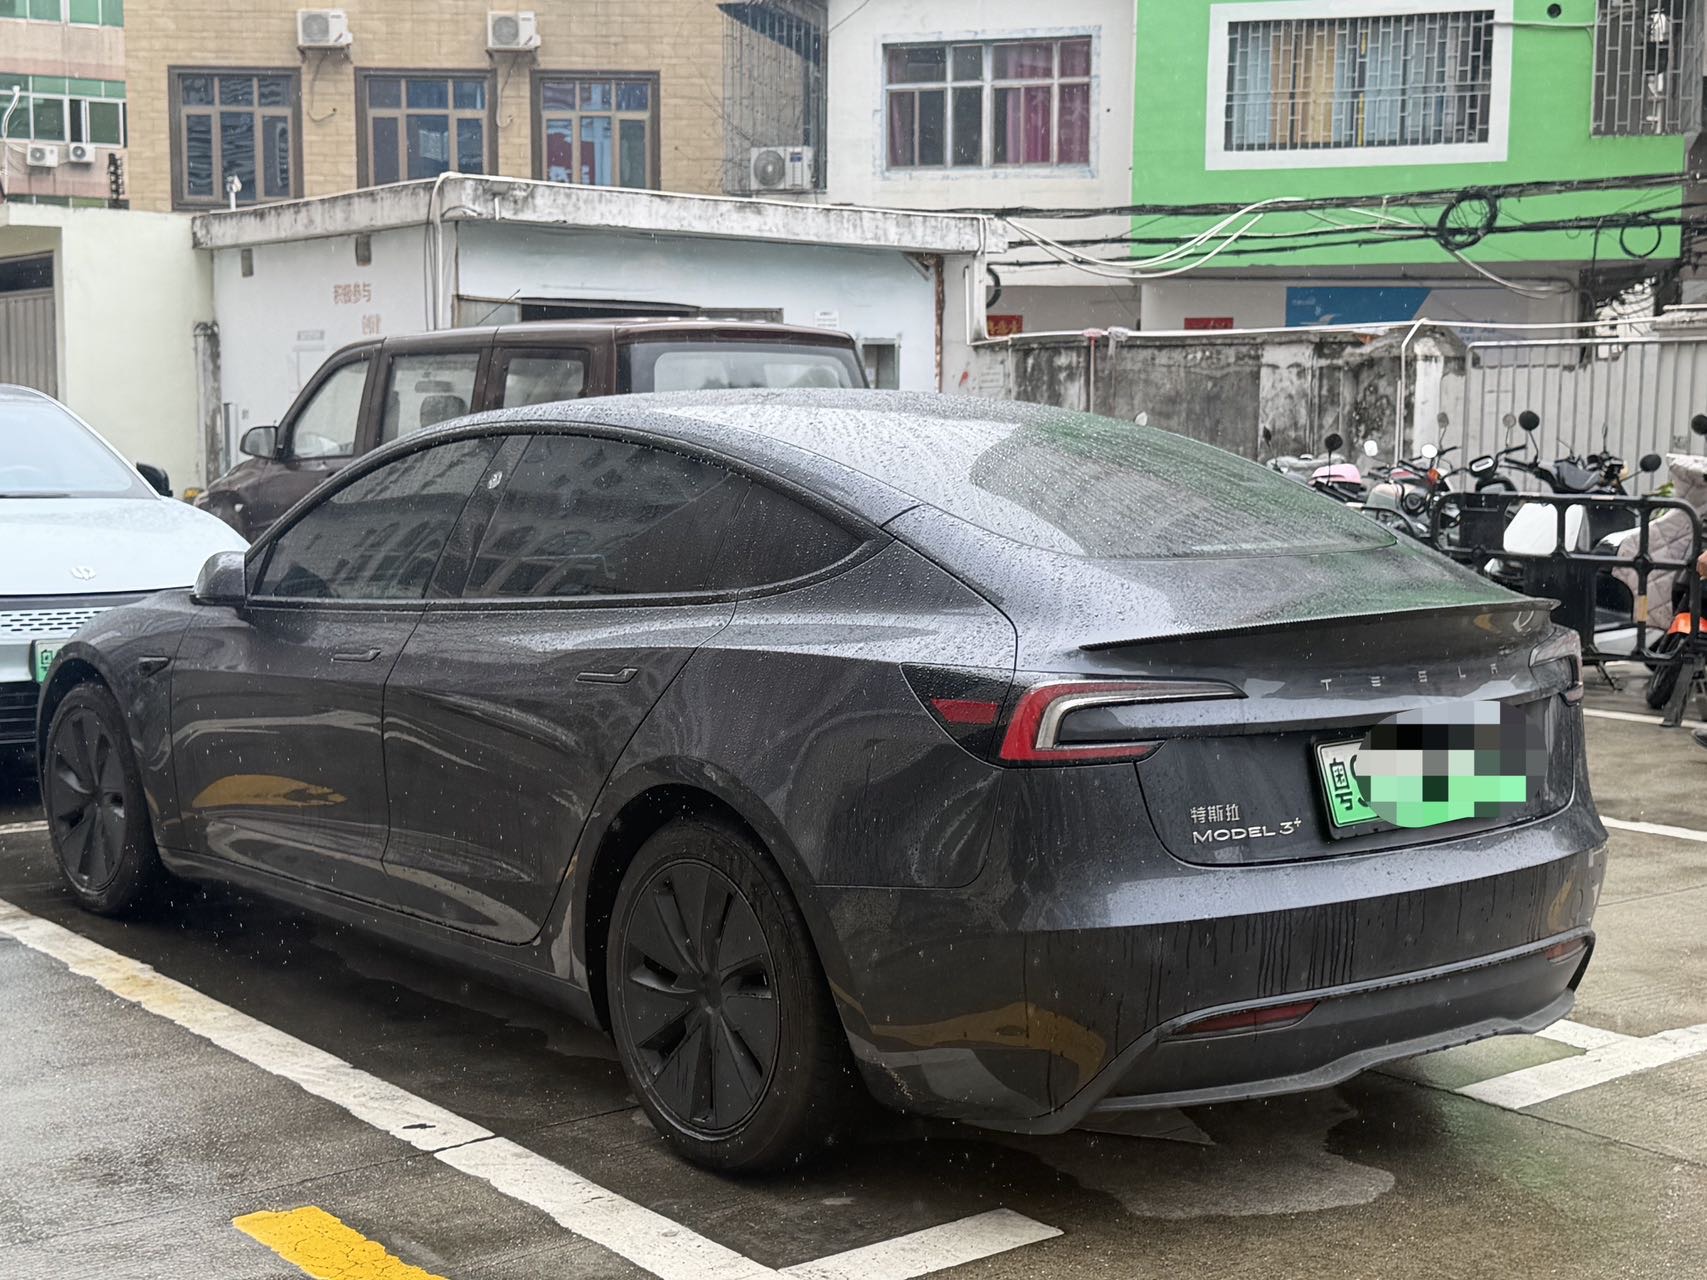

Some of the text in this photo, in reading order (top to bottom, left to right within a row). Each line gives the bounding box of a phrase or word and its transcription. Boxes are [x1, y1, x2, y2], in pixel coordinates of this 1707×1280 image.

[1190, 803, 1240, 824] 特斯拉
[1192, 825, 1276, 844] MODEL
